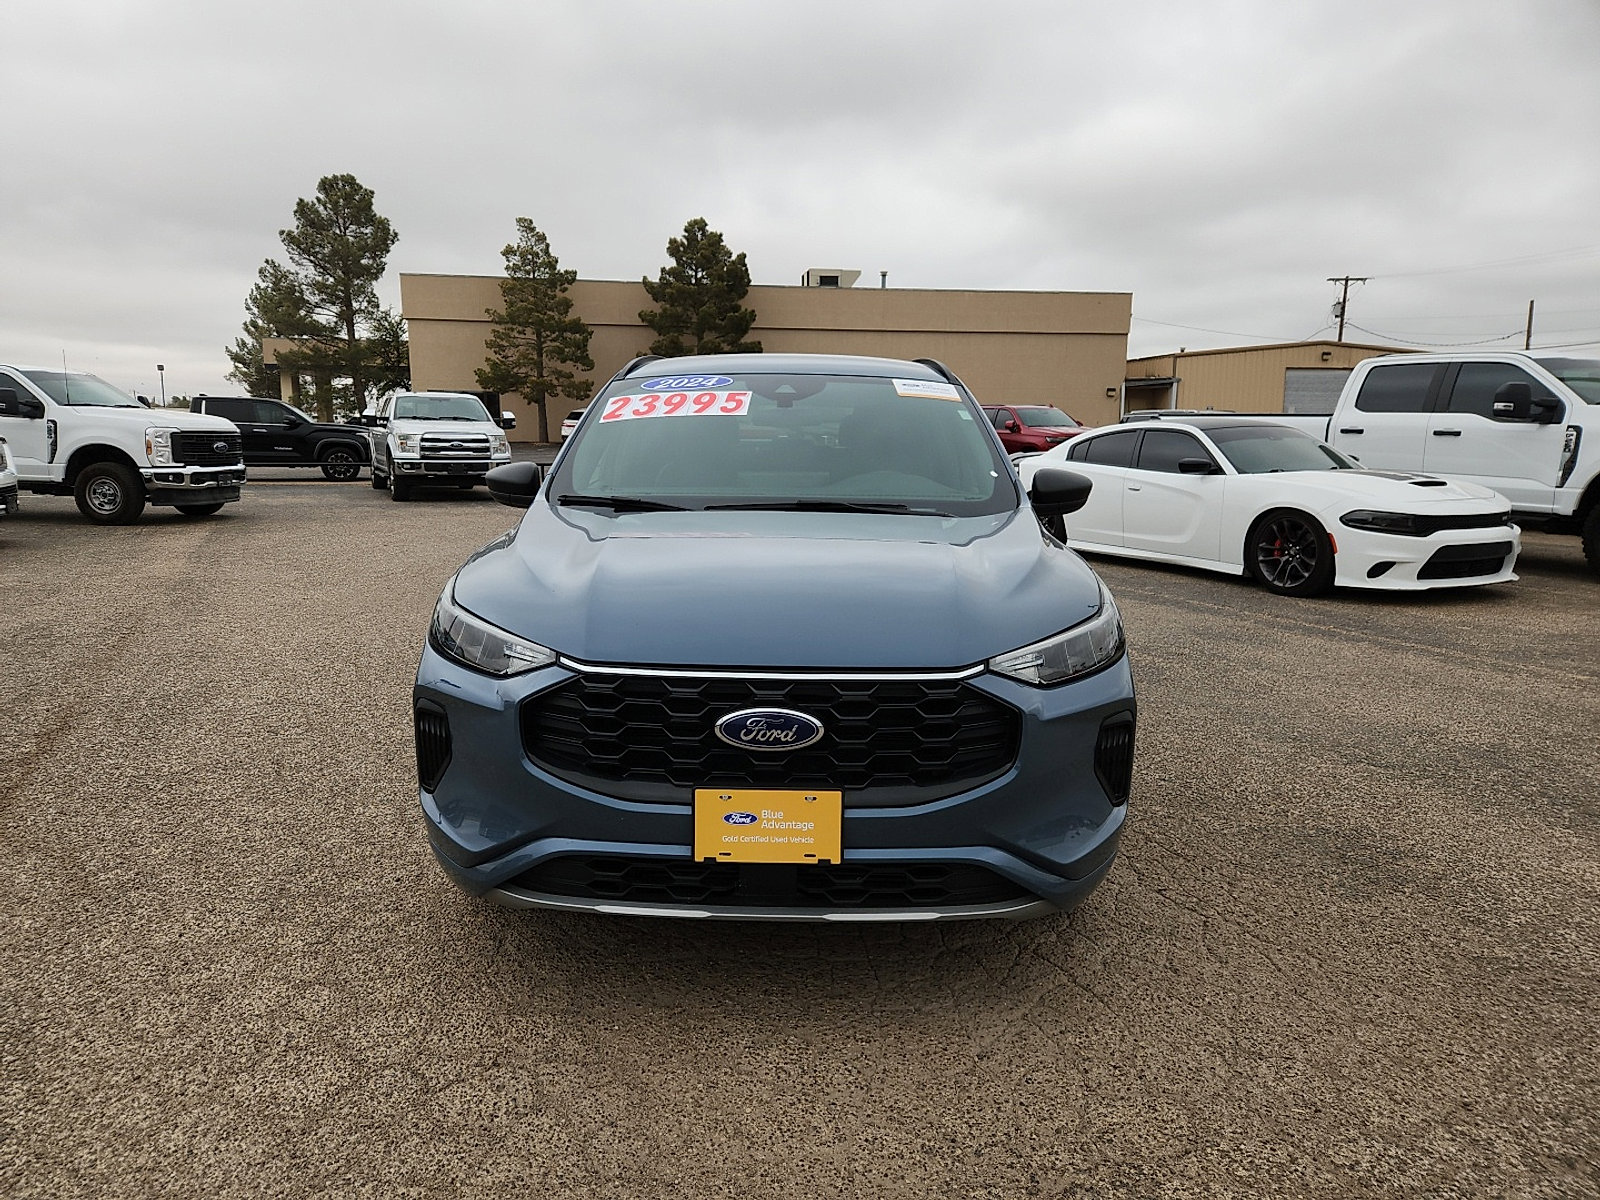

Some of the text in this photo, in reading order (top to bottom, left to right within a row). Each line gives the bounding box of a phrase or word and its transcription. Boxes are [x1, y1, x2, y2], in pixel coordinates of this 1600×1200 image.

[654, 376, 719, 390] 2024
[602, 392, 748, 421] 23995
[740, 717, 799, 742] Ford
[729, 813, 752, 824] Ford
[761, 809, 784, 819] Blue
[761, 820, 815, 831] Advantage
[722, 835, 815, 844] Gold Certified Used Vehicle
